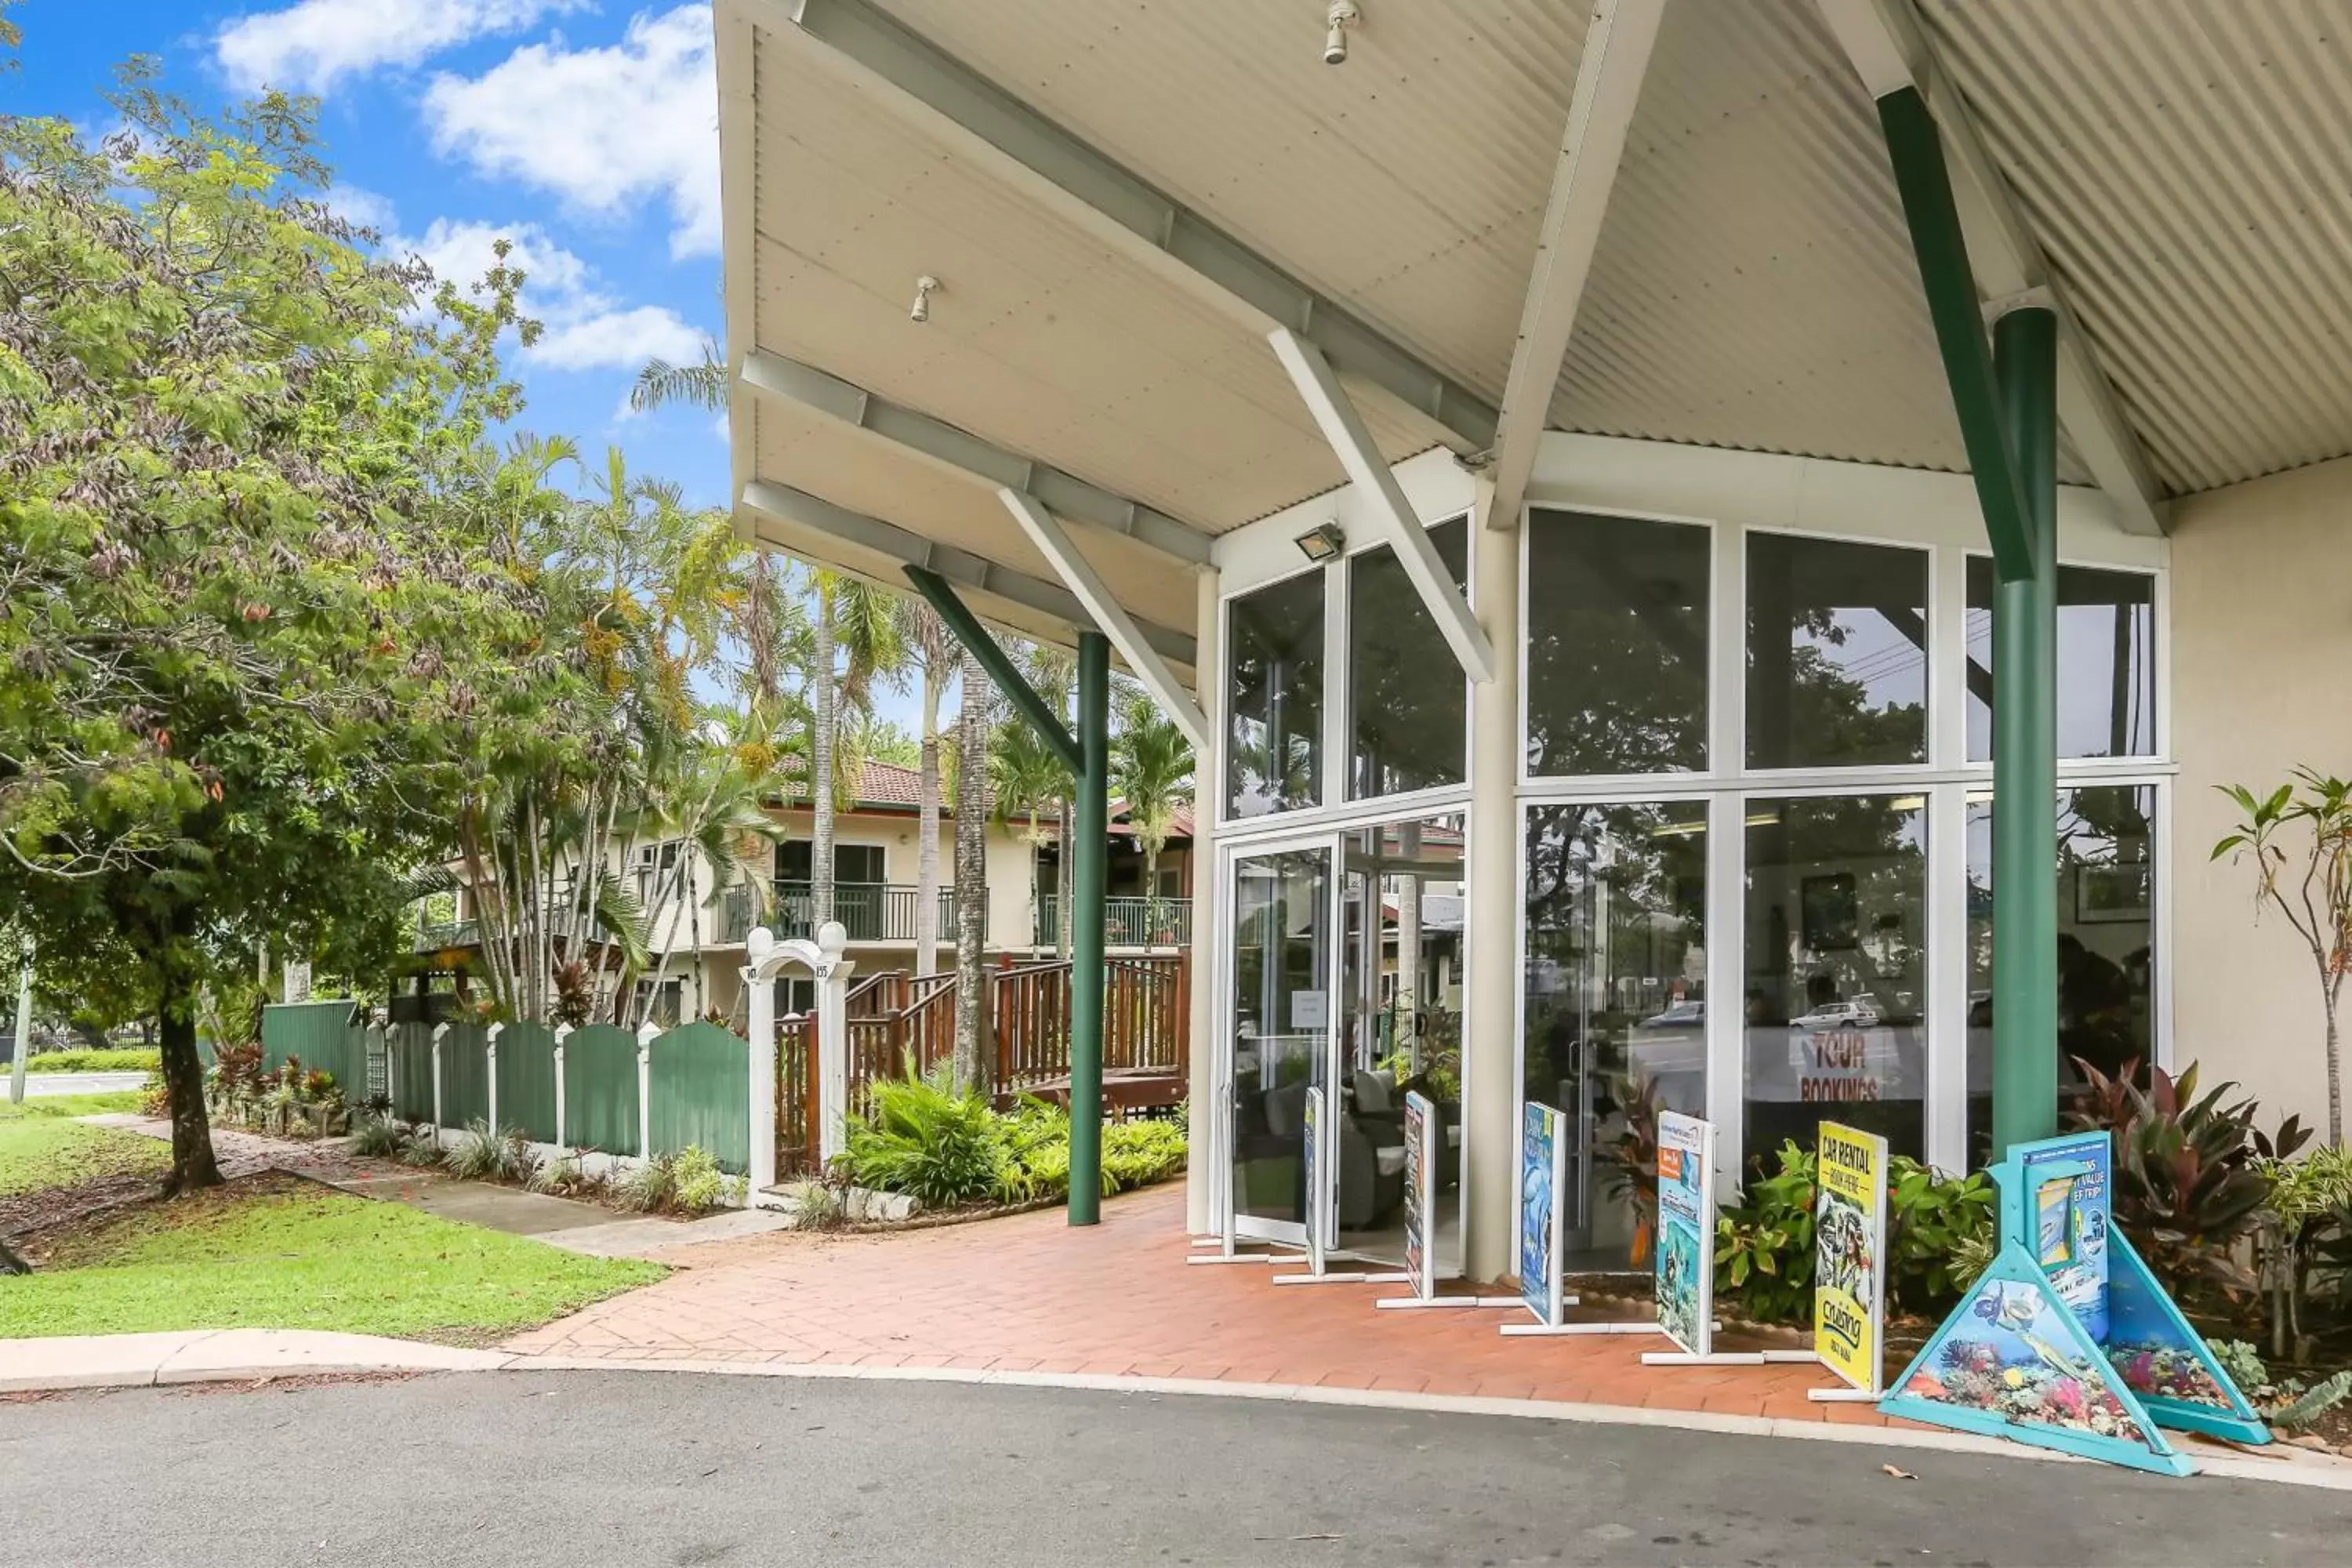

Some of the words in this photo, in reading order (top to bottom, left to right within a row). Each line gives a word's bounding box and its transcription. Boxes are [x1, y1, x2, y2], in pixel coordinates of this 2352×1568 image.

[1813, 1033, 1866, 1069] TOUR
[1801, 1076, 1879, 1102] BOOKINGS
[1823, 1135, 1837, 1163] CAR
[1838, 1141, 1870, 1175] RENTAL
